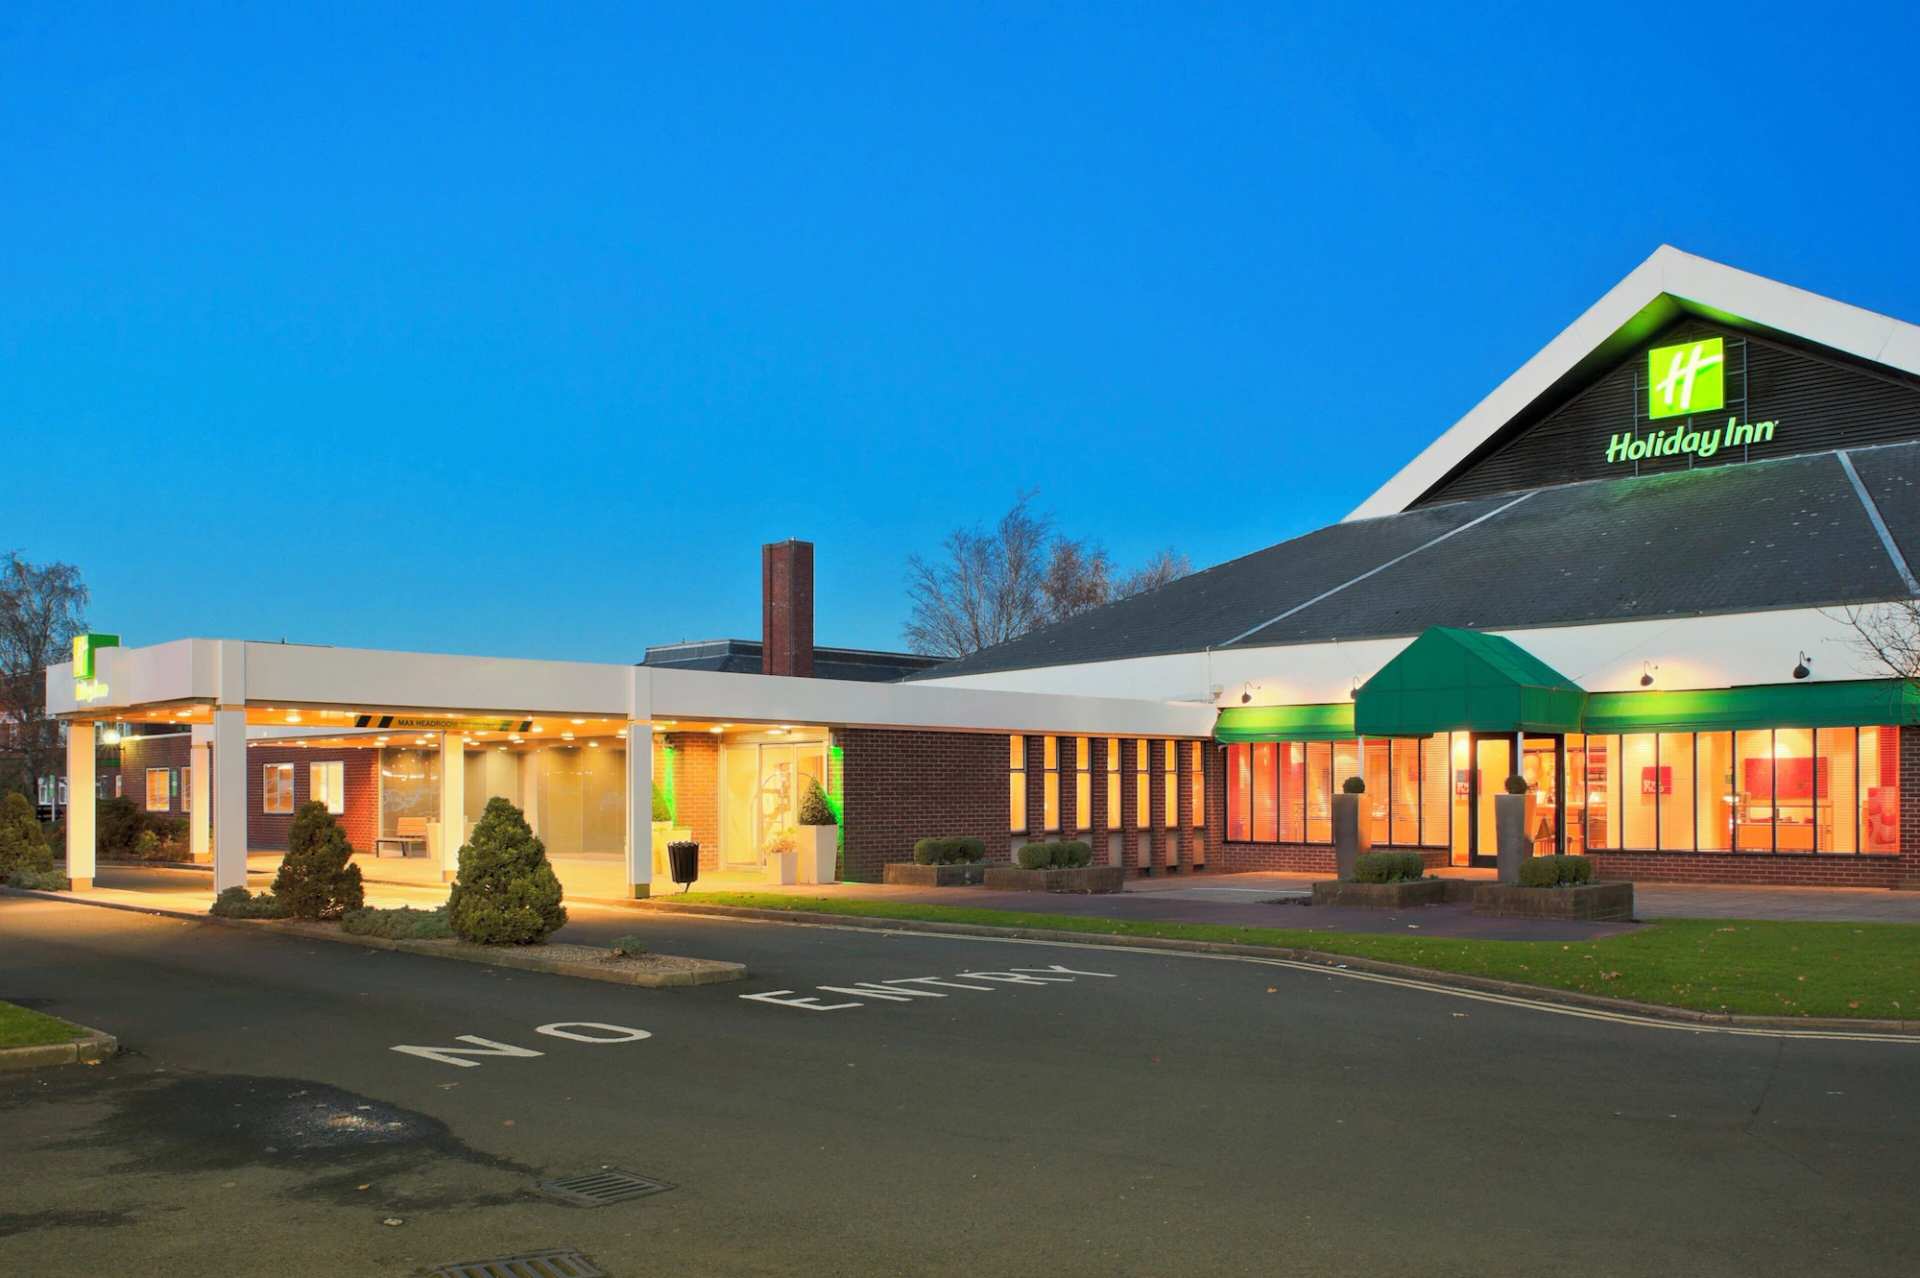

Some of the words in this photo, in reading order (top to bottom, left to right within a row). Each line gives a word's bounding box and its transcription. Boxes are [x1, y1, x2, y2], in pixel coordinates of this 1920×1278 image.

[1605, 425, 1721, 463] Holiday
[1724, 416, 1774, 447] Inn
[398, 719, 414, 727] MAX
[389, 1021, 653, 1068] NO
[738, 963, 1118, 1012] ENTRY
